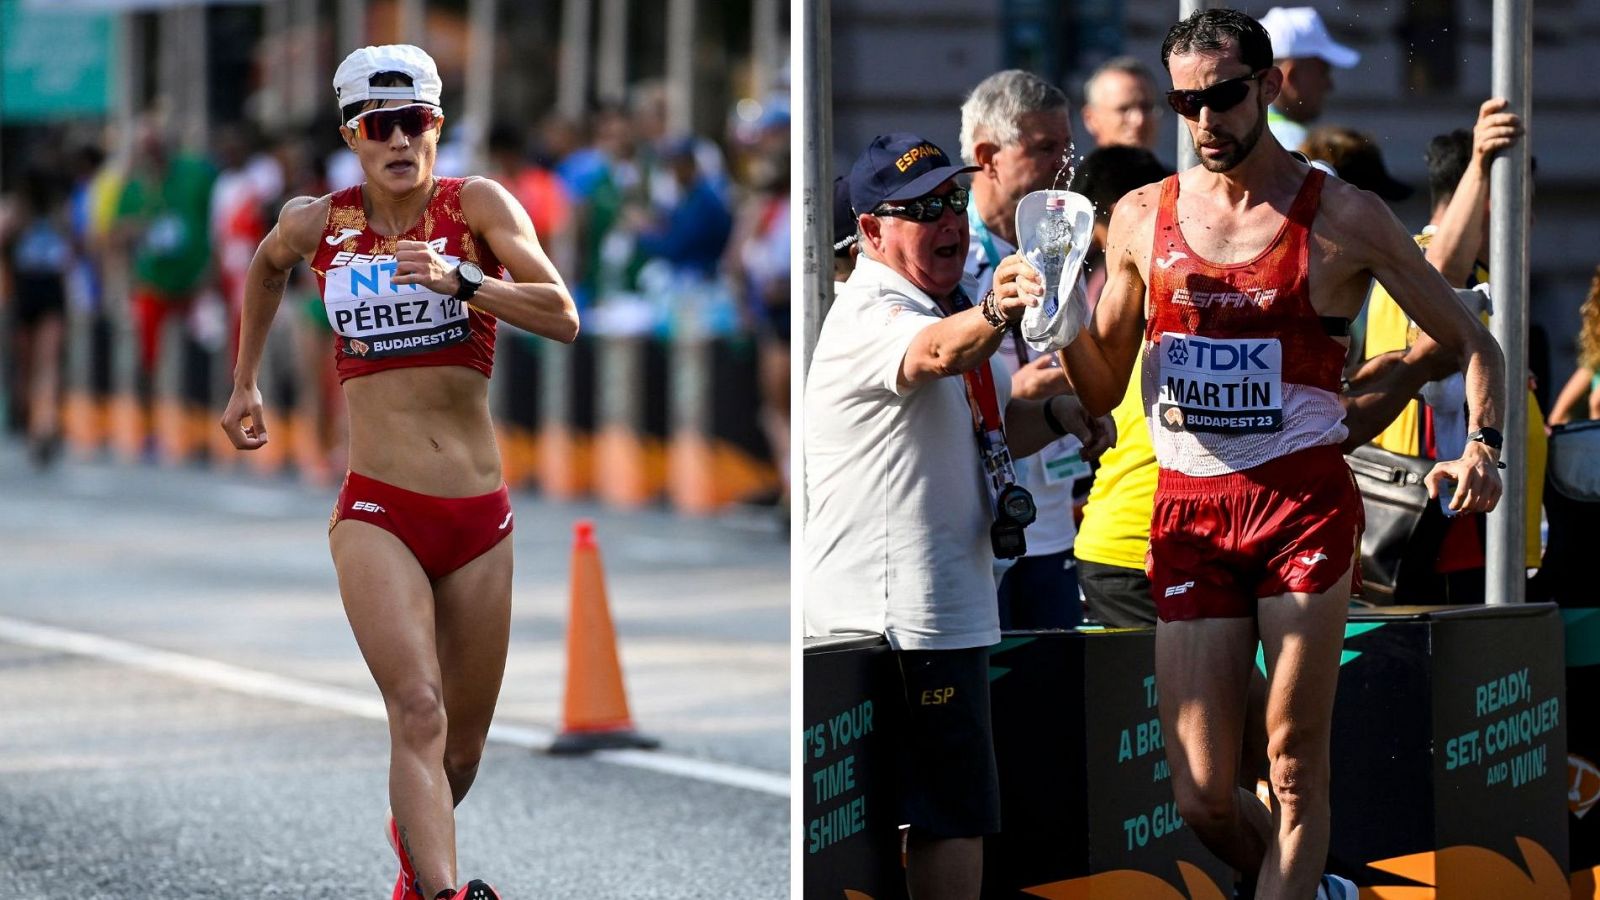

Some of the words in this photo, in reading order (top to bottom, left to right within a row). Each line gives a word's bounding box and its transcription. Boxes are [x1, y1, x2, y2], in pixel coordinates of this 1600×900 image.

[895, 144, 941, 172] ESPAÑA
[330, 237, 448, 266] ESPA
[350, 262, 417, 297] NT
[1171, 288, 1278, 309] ESPAÑA
[335, 300, 433, 333] PÉREZ
[373, 332, 446, 352] BUDAPEST
[448, 326, 463, 339] 23
[1188, 340, 1270, 371] TDK
[1167, 376, 1270, 408] MARTÍN
[1187, 414, 1255, 428] BUDAPEST
[1256, 415, 1273, 426] 23
[1164, 580, 1195, 598] ESP
[921, 686, 955, 706] ESP
[1476, 667, 1531, 717] READY,
[803, 723, 826, 764] T'S
[828, 700, 874, 750] YOUR
[1118, 729, 1133, 763] A
[1136, 718, 1165, 756] BR
[1446, 729, 1482, 770] SET,
[1484, 696, 1560, 756] CONQUER
[812, 755, 856, 804] TIME
[1153, 760, 1170, 782] AN
[1486, 762, 1508, 787] AND
[1510, 743, 1547, 789] WIN!
[809, 795, 865, 854] SHINE!
[1124, 814, 1149, 850] TO
